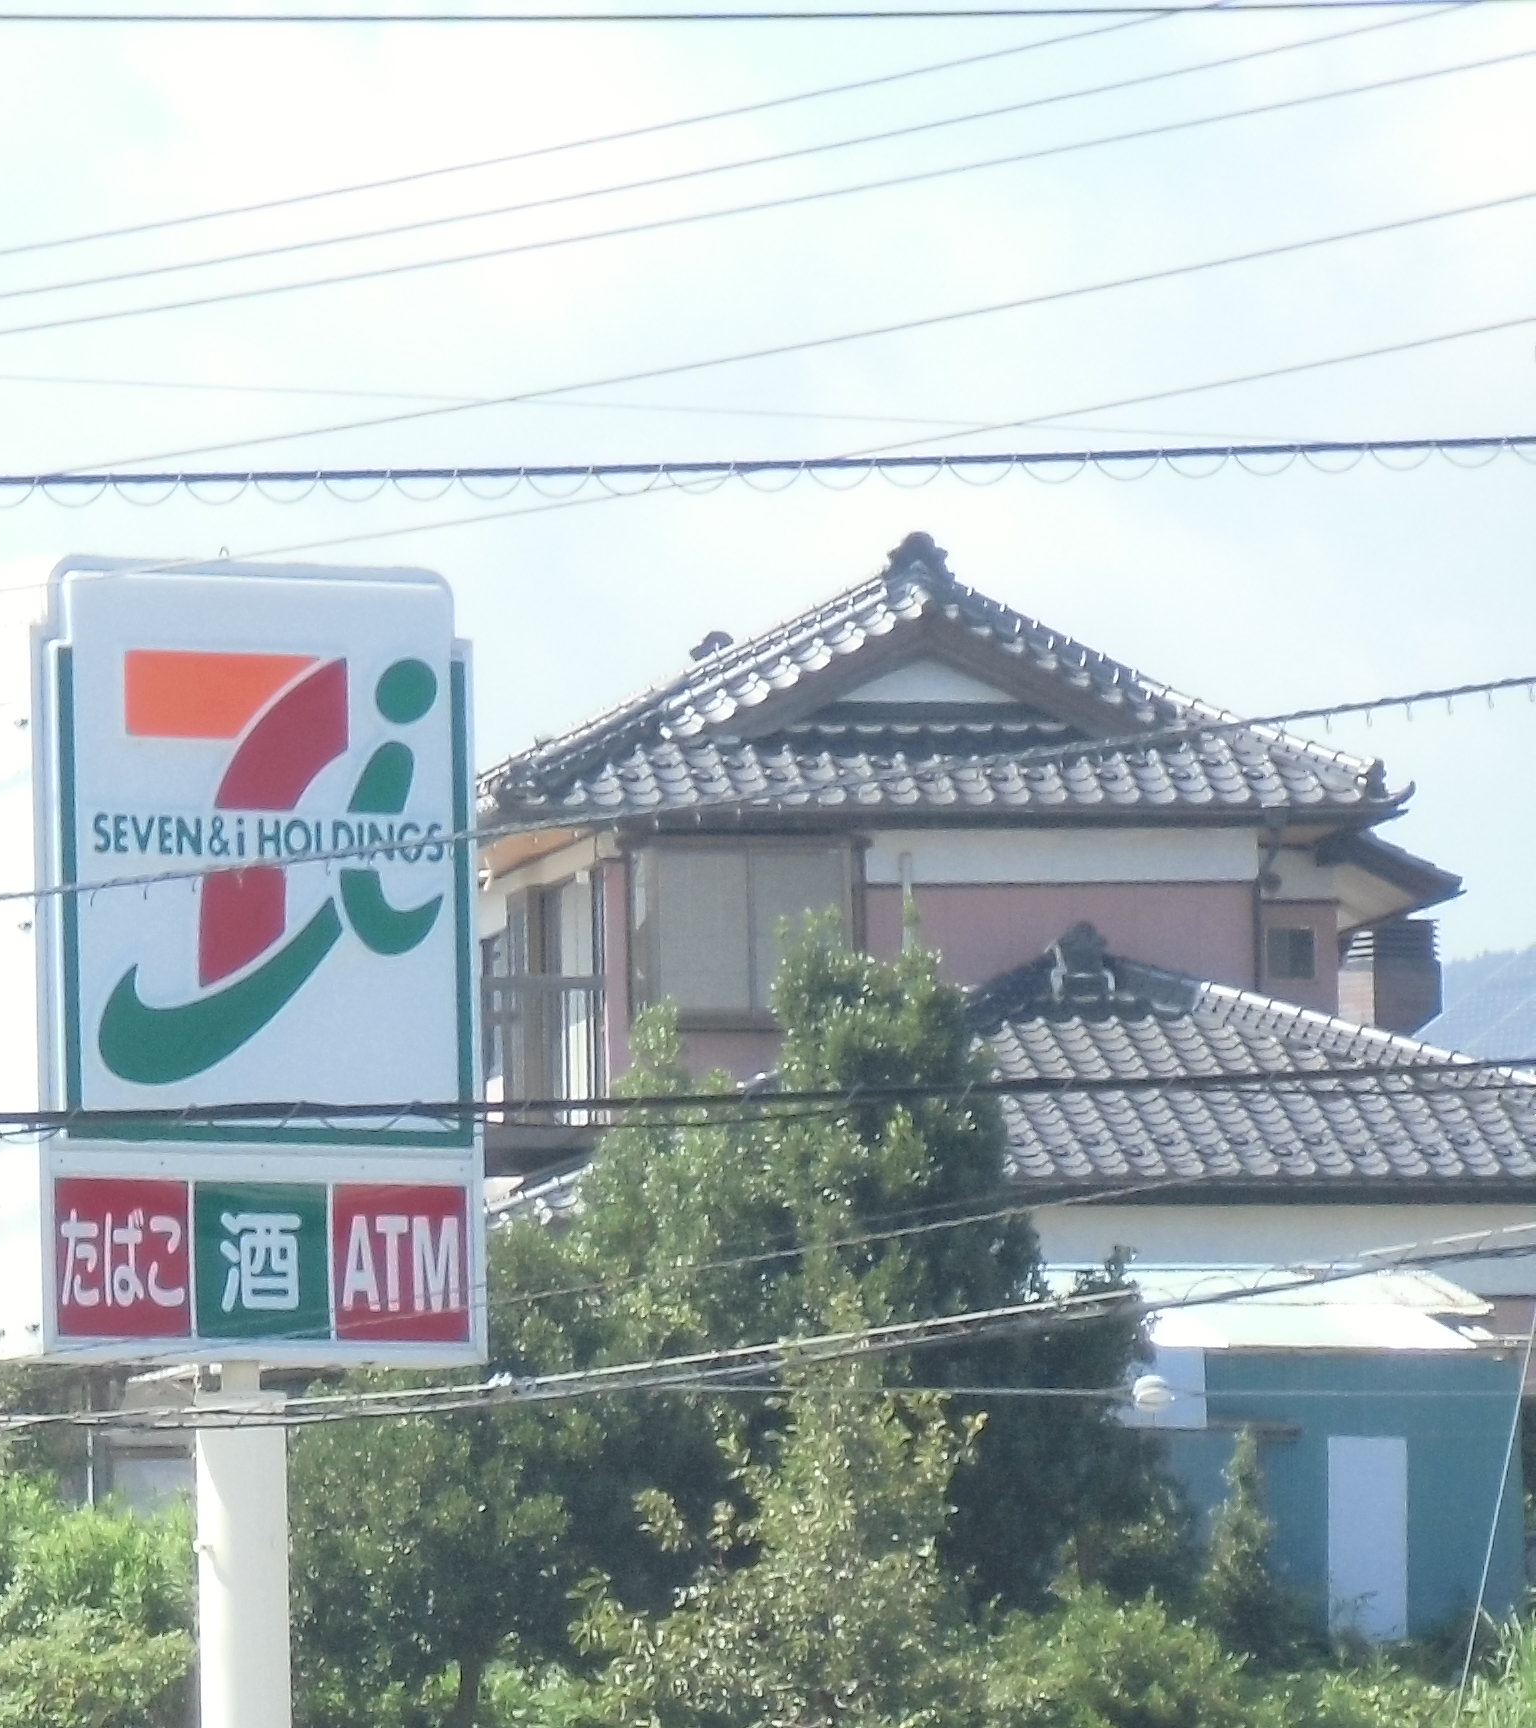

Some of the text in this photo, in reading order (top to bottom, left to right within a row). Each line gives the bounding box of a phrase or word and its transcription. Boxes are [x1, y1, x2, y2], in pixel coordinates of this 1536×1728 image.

[257, 818, 444, 863] HOLDINGS
[60, 1207, 186, 1308] たばこ
[219, 1211, 303, 1313] 酒
[342, 1213, 461, 1314] ATM
